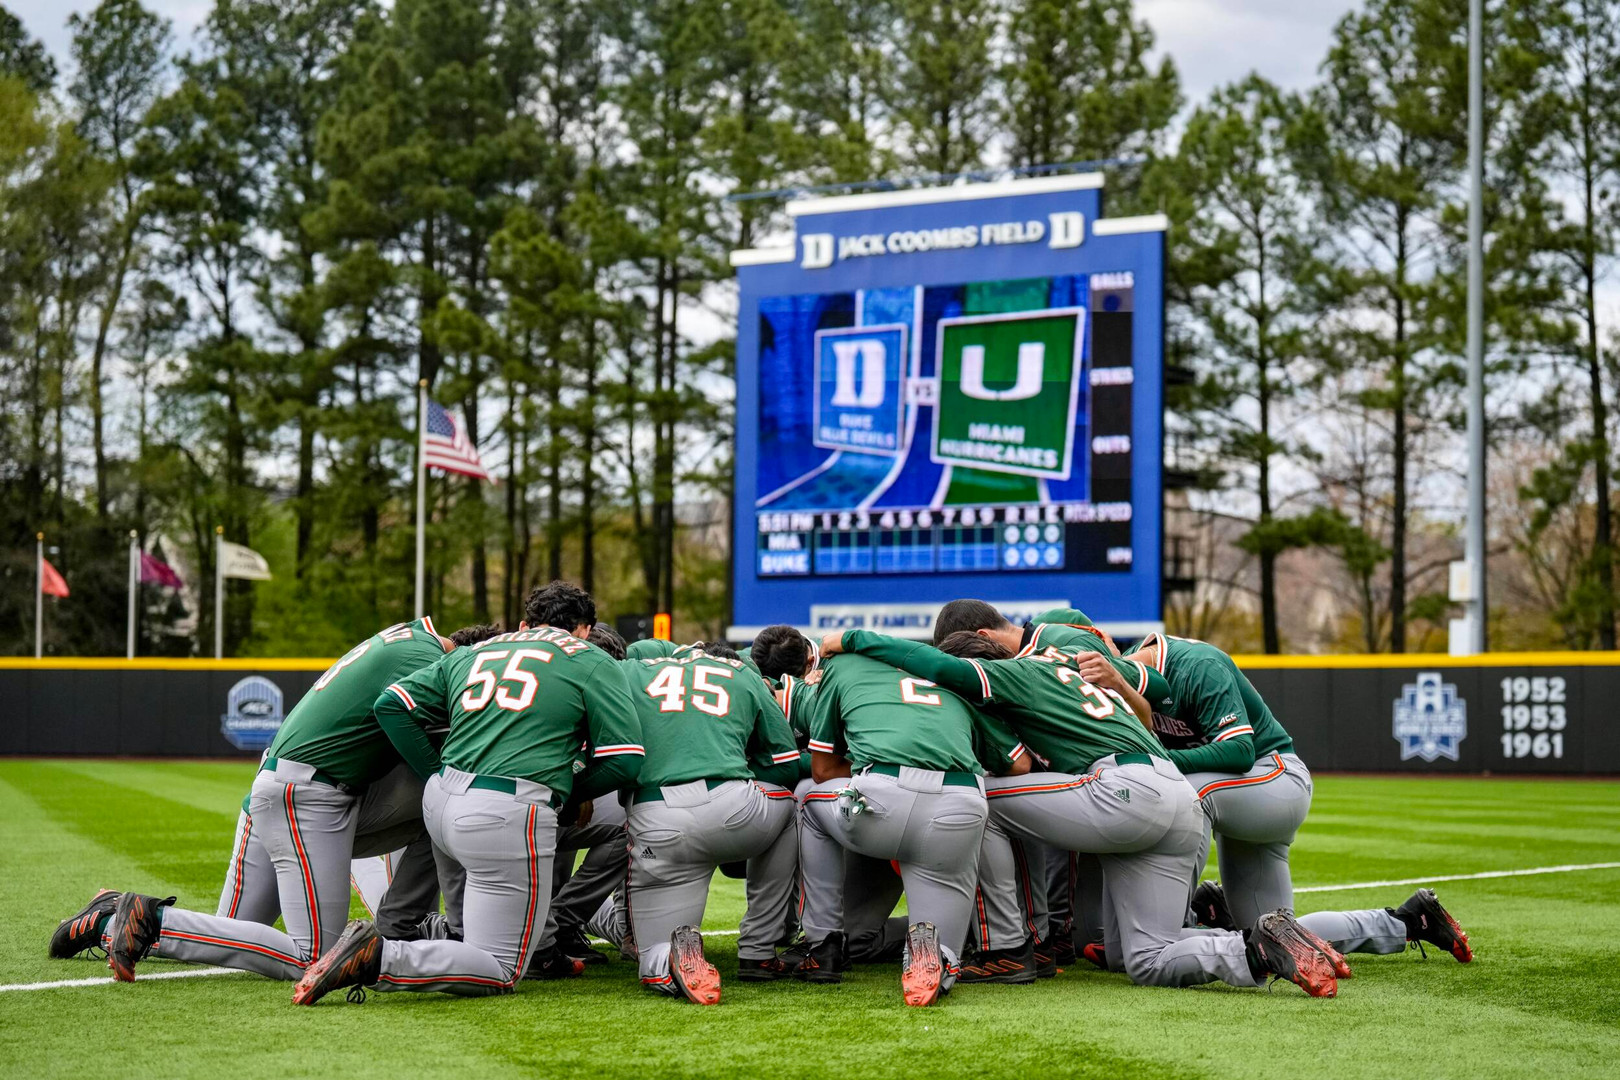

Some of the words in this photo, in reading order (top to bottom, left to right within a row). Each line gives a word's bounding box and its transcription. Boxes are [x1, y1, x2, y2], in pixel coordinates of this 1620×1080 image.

[800, 232, 834, 269] D
[838, 234, 886, 260] JACK
[886, 226, 978, 254] COOMBS
[981, 220, 1045, 246] FIELD
[1048, 211, 1085, 249] D
[1090, 271, 1134, 290] BALLS
[831, 339, 887, 408] D
[960, 342, 1045, 401] U
[968, 422, 1026, 445] MIAMI
[1092, 435, 1132, 454] OUTS
[940, 438, 1059, 469] HURRICANES
[822, 512, 832, 531] 1
[837, 511, 851, 530] 2
[856, 510, 870, 530] 3
[879, 510, 895, 529] 4
[899, 509, 913, 529] 5
[917, 509, 932, 528] 6
[940, 508, 956, 527] 7
[960, 507, 976, 526] 8
[979, 506, 995, 526] 9
[1004, 505, 1020, 524] R
[1024, 505, 1040, 523] H
[1044, 504, 1058, 523] E
[768, 533, 802, 552] MIA
[761, 553, 810, 573] DUKE
[461, 648, 554, 712] 55
[646, 665, 734, 718] 45
[1500, 676, 1567, 703] 1952
[1152, 711, 1195, 737] CANES
[1218, 713, 1238, 727] ACC
[1500, 704, 1568, 731] 1953
[1500, 732, 1565, 758] 1961
